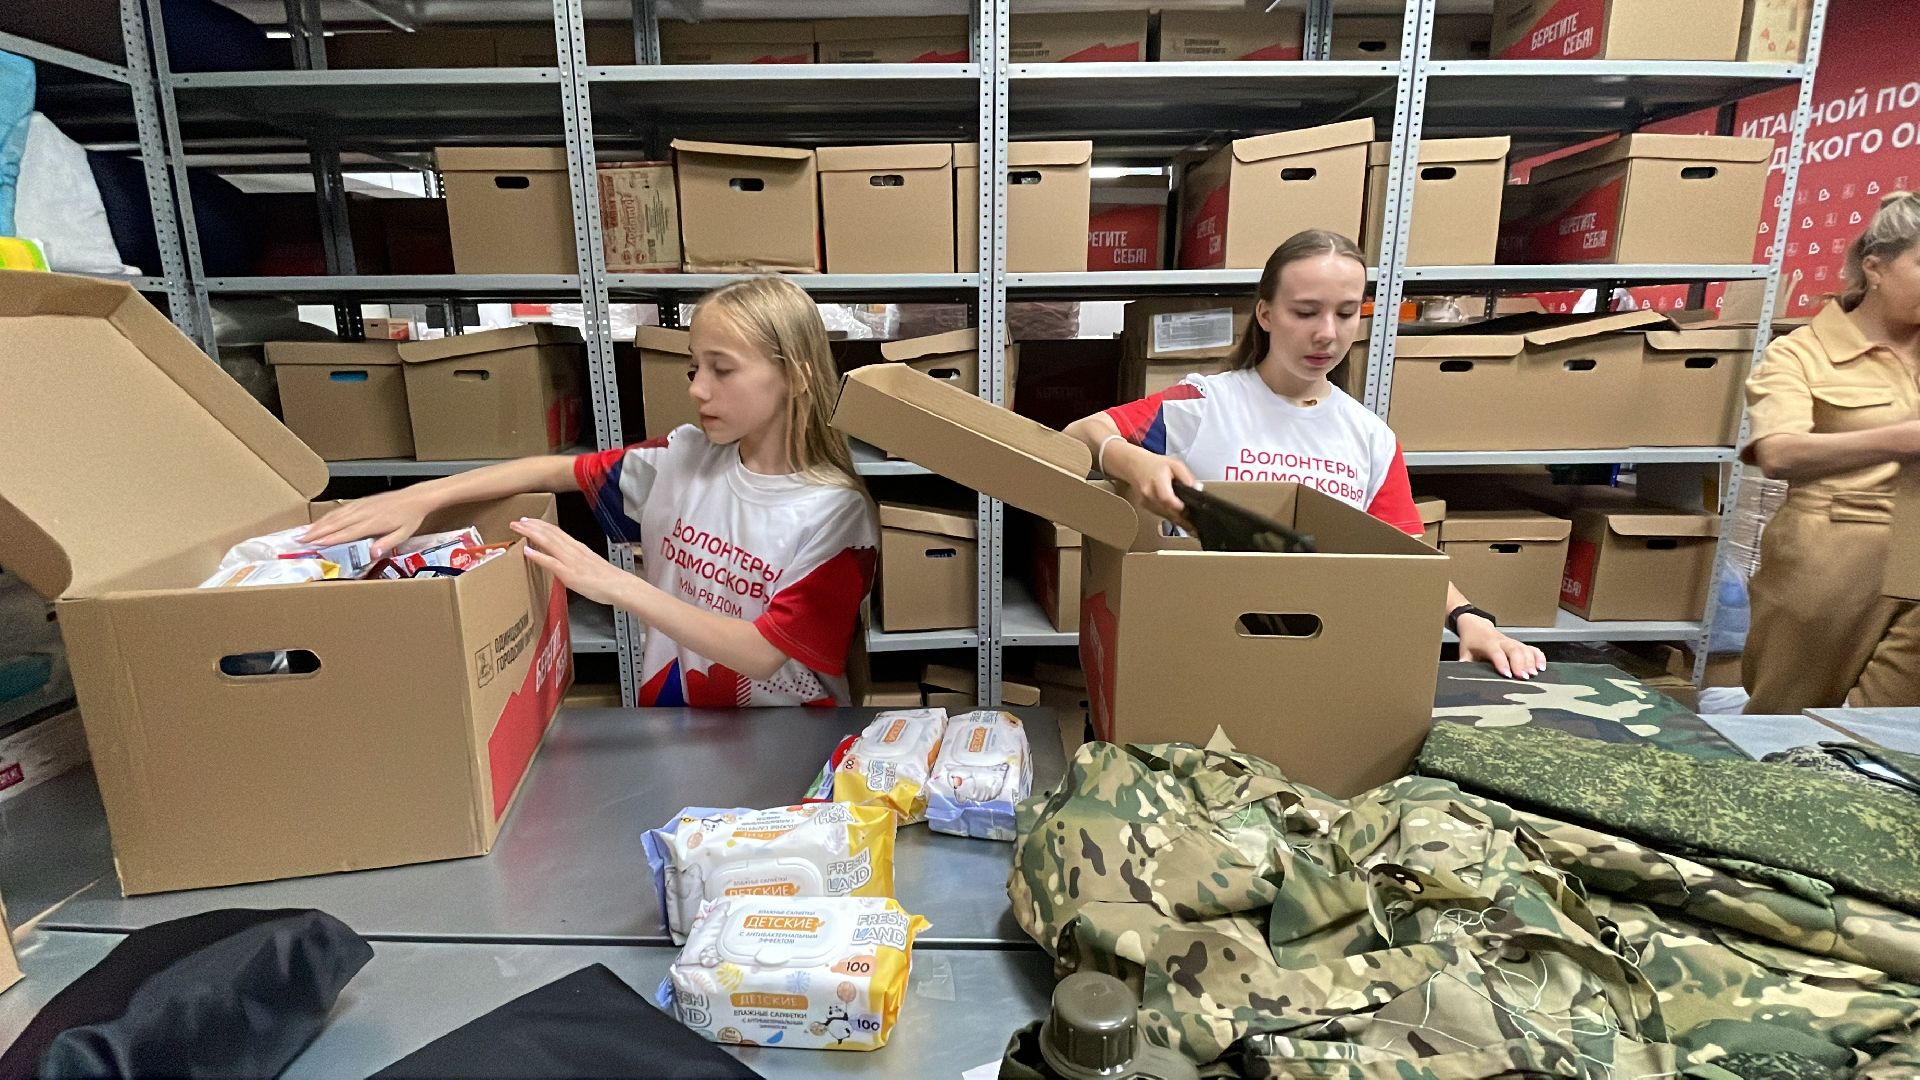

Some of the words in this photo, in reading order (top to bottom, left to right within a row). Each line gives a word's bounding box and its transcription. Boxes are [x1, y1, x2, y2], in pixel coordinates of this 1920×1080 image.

[1531, 12, 1579, 51] БЕРЕГИТЕ
[1563, 26, 1594, 56] СЕБЯ!
[1741, 87, 1868, 138] ИТАНОЙ
[1892, 122, 1920, 149] О
[1113, 248, 1147, 264] СЕБЯ!
[1240, 448, 1358, 480] ВОЛОНТЕРЫ
[672, 518, 784, 583] ВОЛОНТЕРЫ
[679, 577, 697, 597] МЫ
[699, 589, 742, 618] РЯДОМ
[827, 866, 870, 893] LAND
[746, 916, 814, 929] ДЕТСКИЕ
[857, 913, 908, 928] FRESH
[852, 927, 906, 947] LAND
[846, 961, 870, 973] 100
[740, 994, 800, 1006] ДЕТСКИЕ
[857, 1018, 880, 1031] 100
